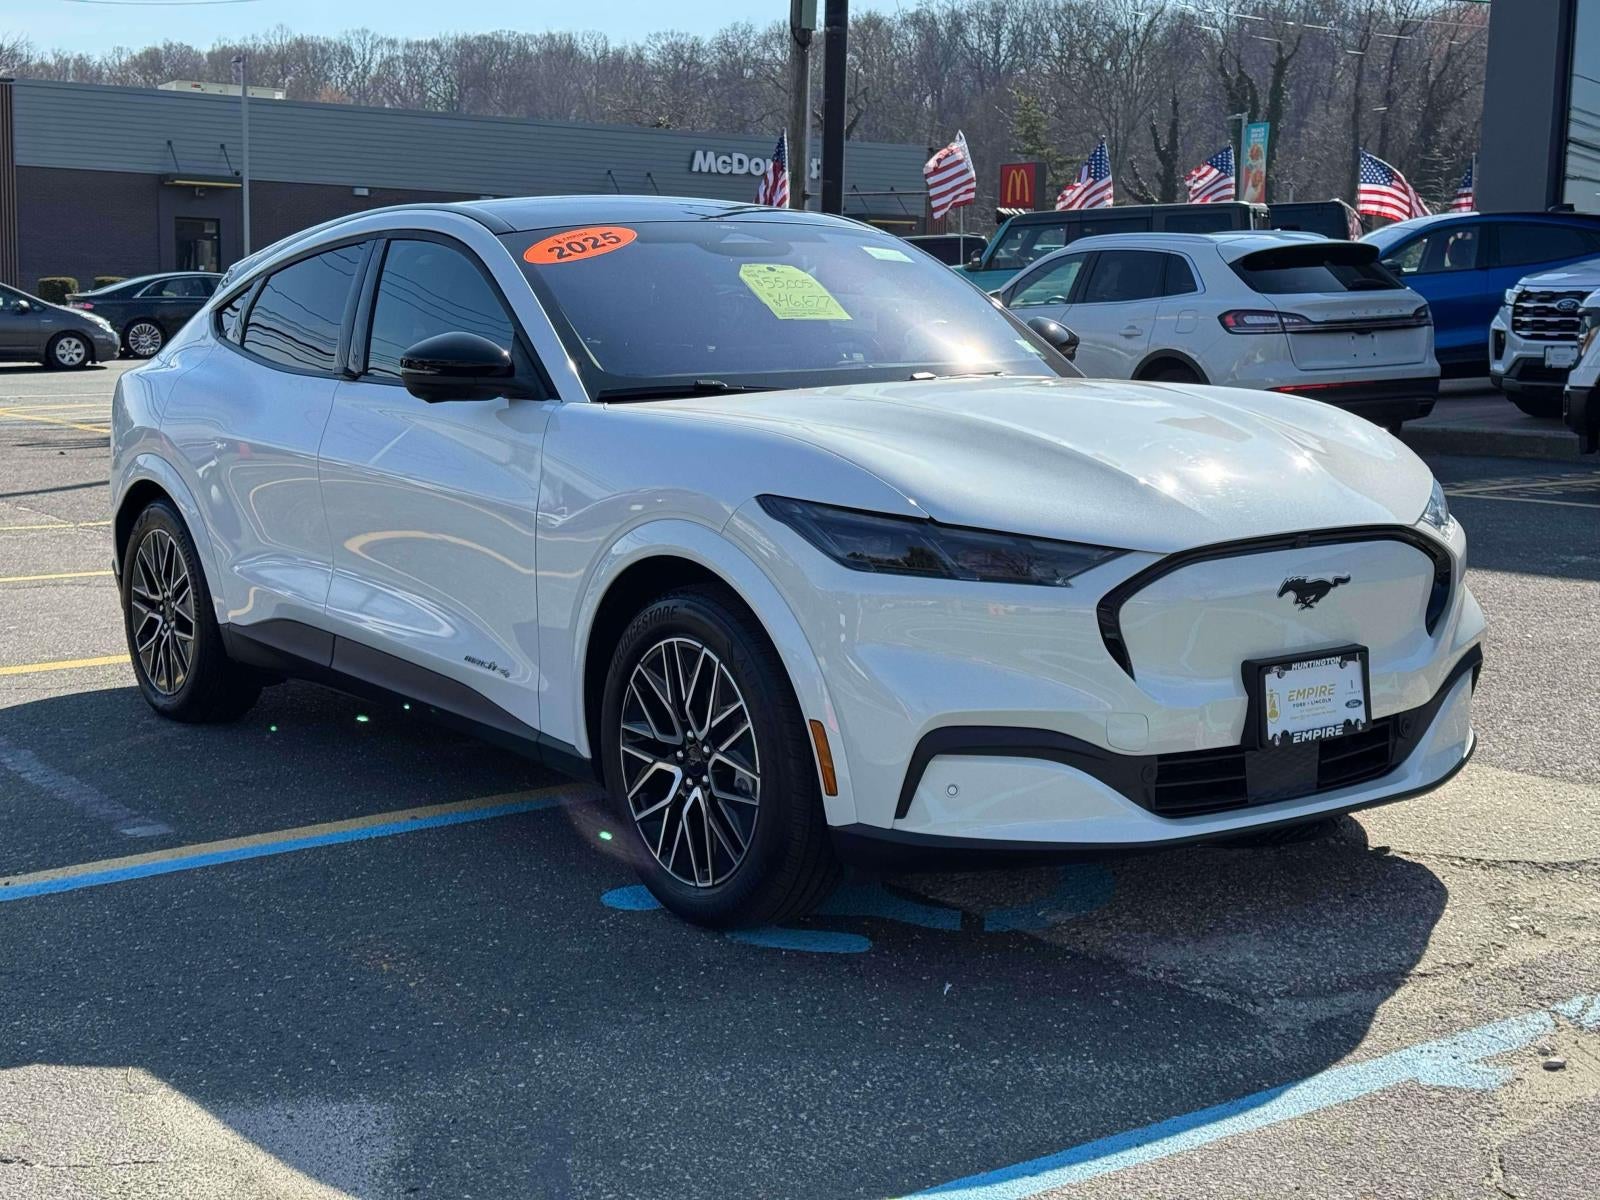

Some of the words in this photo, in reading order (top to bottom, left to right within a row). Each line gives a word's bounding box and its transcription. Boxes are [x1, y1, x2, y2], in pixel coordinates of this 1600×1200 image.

[548, 231, 621, 260] 2025
[1292, 656, 1342, 671] HUNTINGTON
[1288, 684, 1336, 702] EMPIRE
[1292, 724, 1344, 744] EMPIRE
